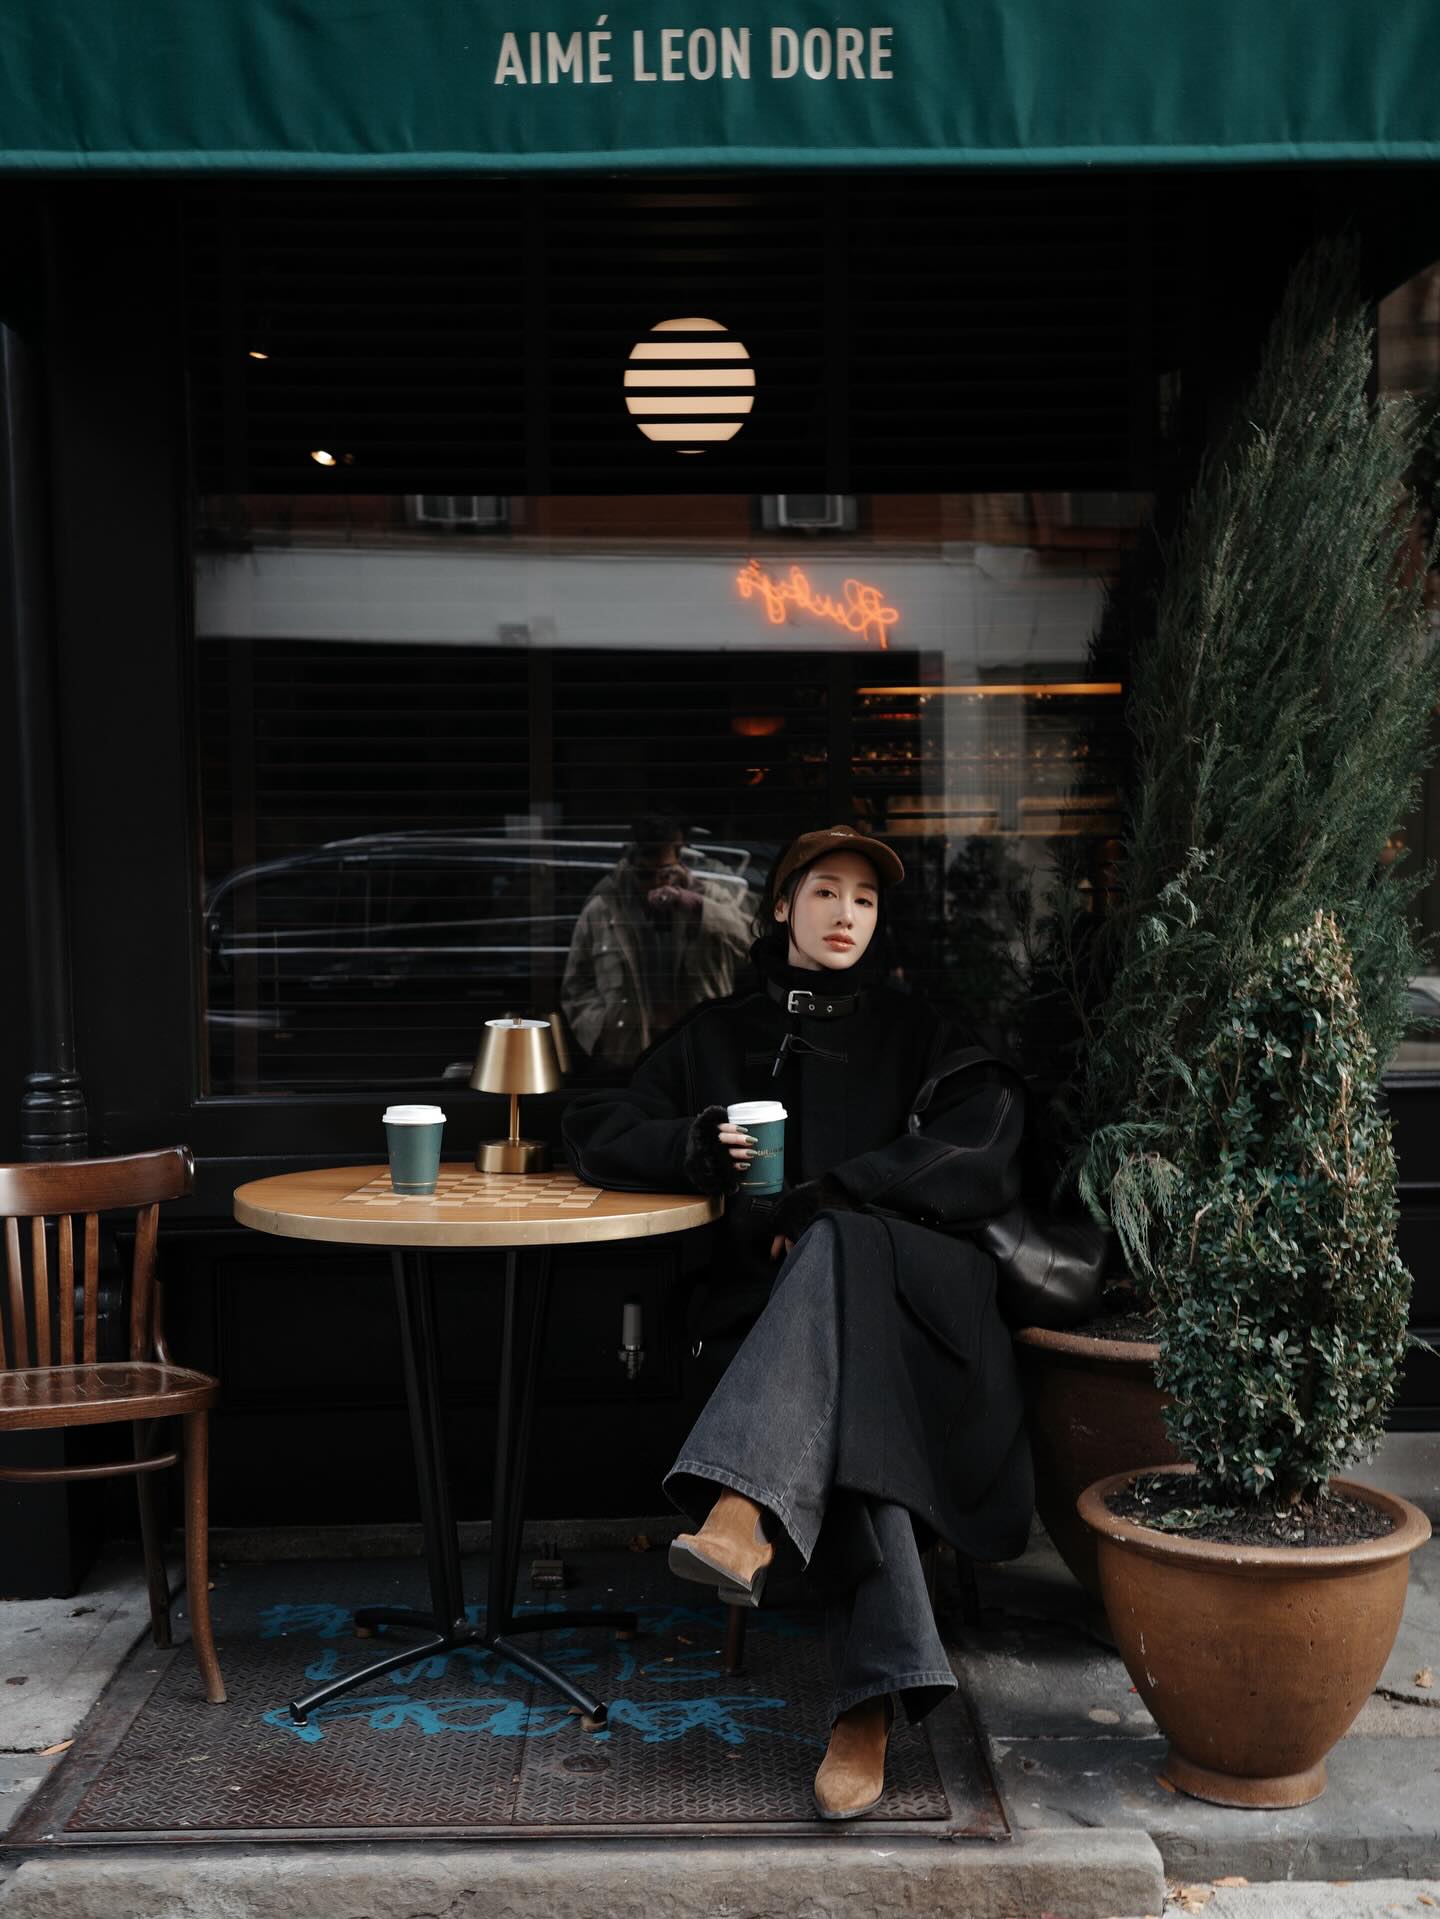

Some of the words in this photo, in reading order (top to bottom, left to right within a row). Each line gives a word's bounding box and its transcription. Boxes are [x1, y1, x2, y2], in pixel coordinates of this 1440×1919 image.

[494, 15, 613, 84] AIMÉ
[633, 27, 751, 82] LEON
[771, 26, 894, 80] DORE
